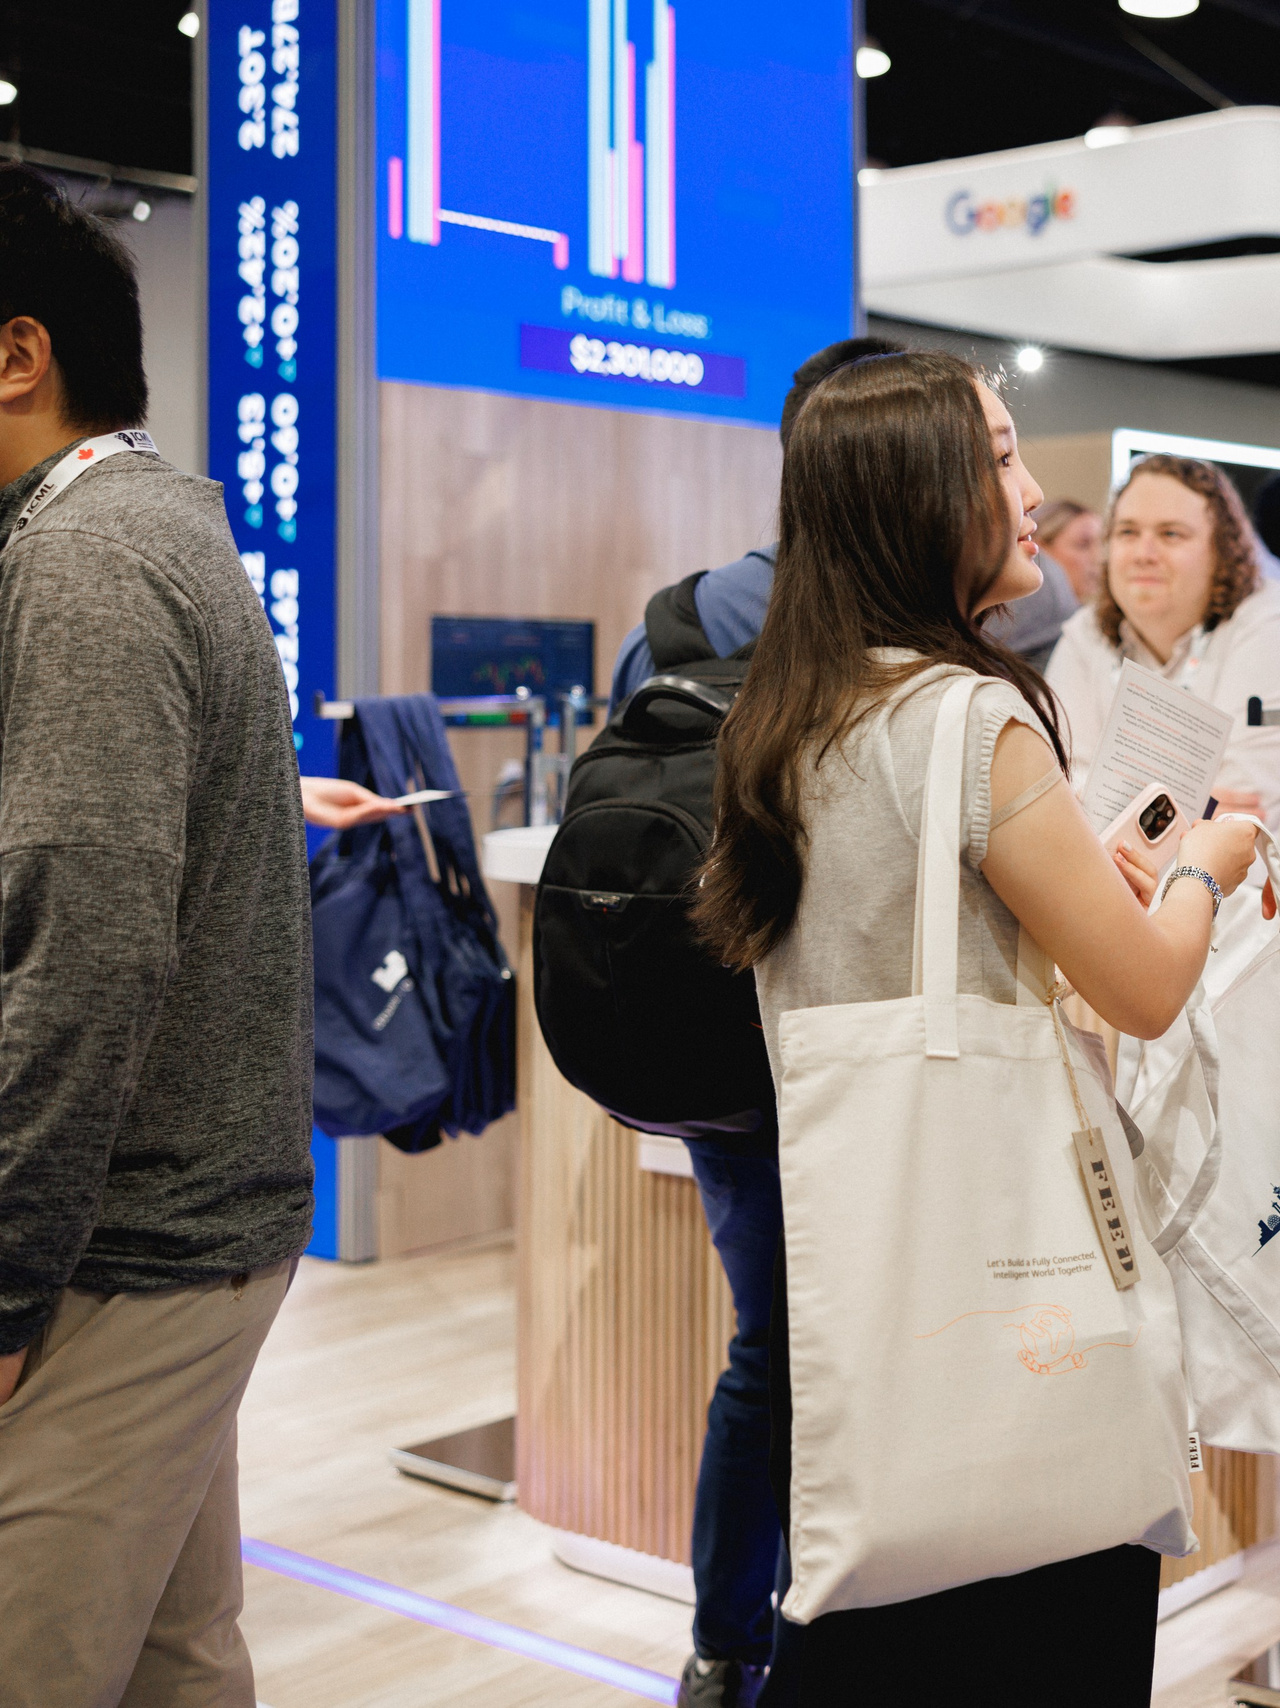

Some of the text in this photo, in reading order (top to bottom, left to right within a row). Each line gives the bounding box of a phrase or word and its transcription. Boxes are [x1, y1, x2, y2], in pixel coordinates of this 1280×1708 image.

[238, 25, 266, 151] 2.30T
[945, 179, 1076, 237] Google
[271, 200, 299, 361] +0.20%
[561, 285, 711, 339] Profit & Loss
[26, 484, 54, 514] ICML
[271, 569, 299, 723] 2.62
[1091, 1158, 1134, 1272] FEED
[986, 1259, 1005, 1268] Let's
[1007, 1258, 1024, 1267] Build
[1032, 1257, 1051, 1267] Fully
[1052, 1250, 1097, 1265] Connected,
[993, 1264, 1092, 1280] Intelligent World Together
[1189, 1437, 1199, 1468] FEED
